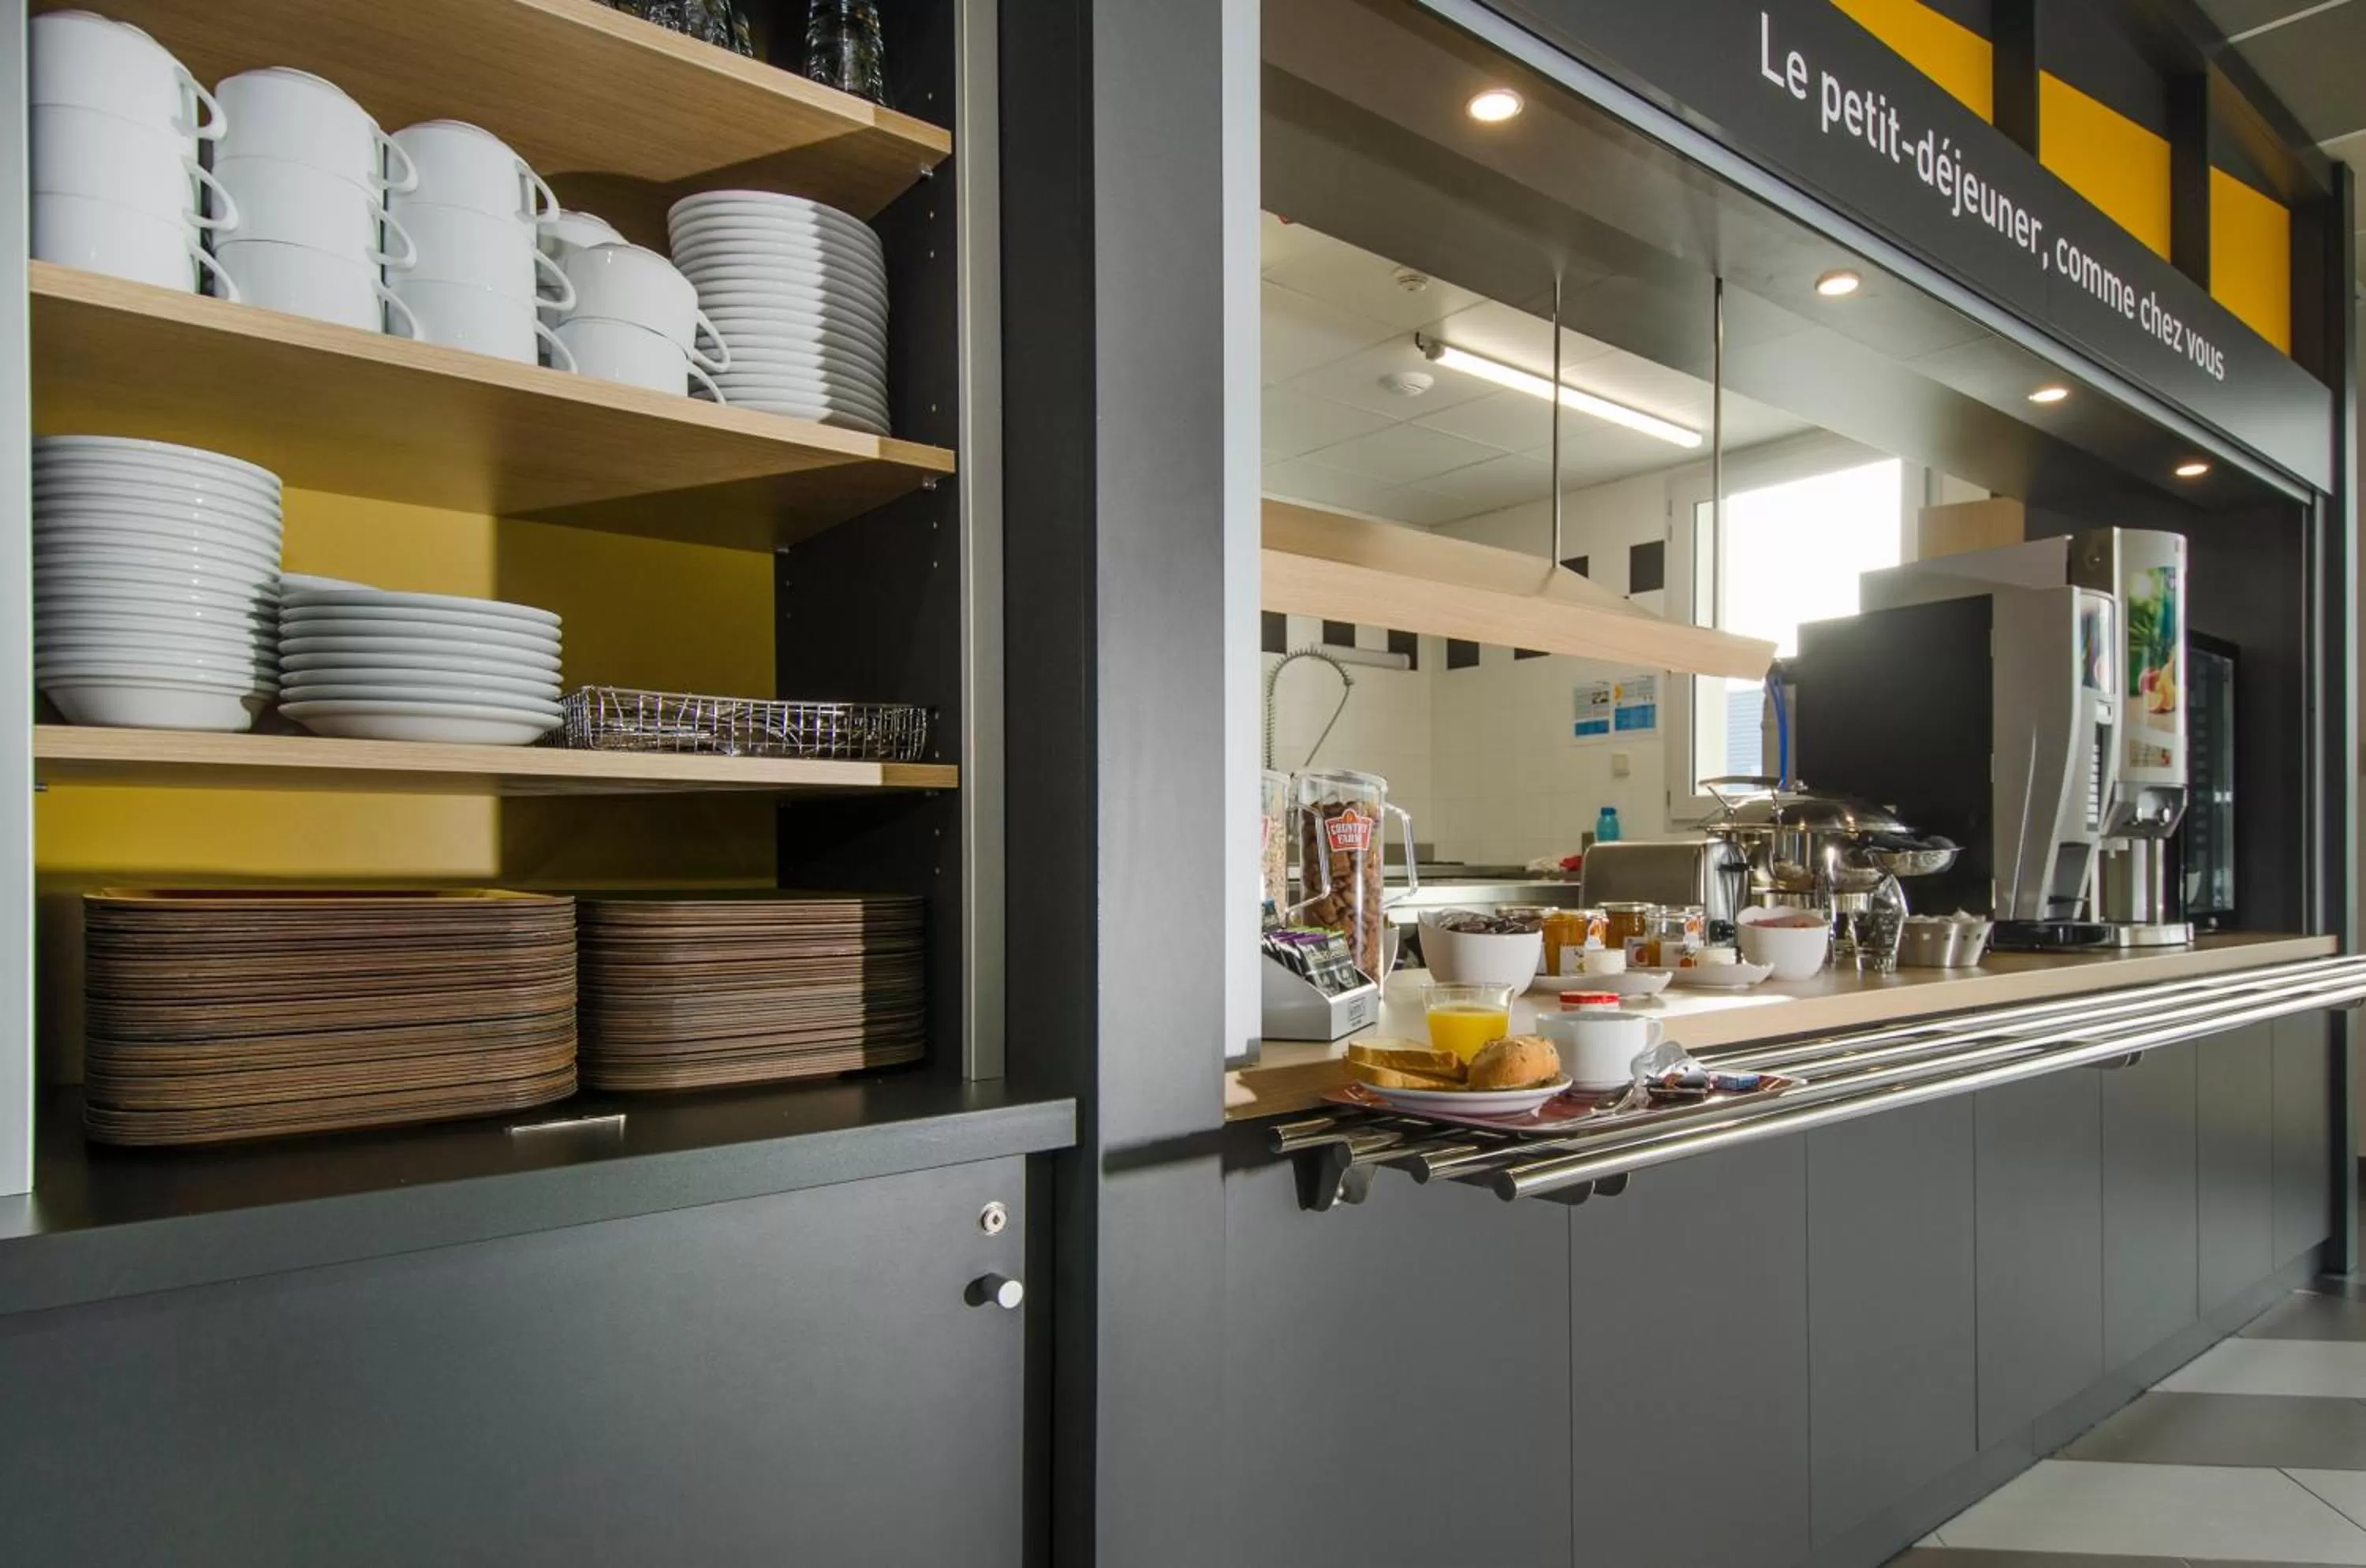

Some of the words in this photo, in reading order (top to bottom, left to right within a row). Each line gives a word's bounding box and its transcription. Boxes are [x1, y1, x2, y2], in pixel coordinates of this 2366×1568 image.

[1760, 11, 1808, 100] Le
[1820, 70, 2049, 271] petit-déjeuner,
[2055, 237, 2136, 320] comme
[2139, 291, 2183, 353] chez
[2185, 327, 2226, 380] vous
